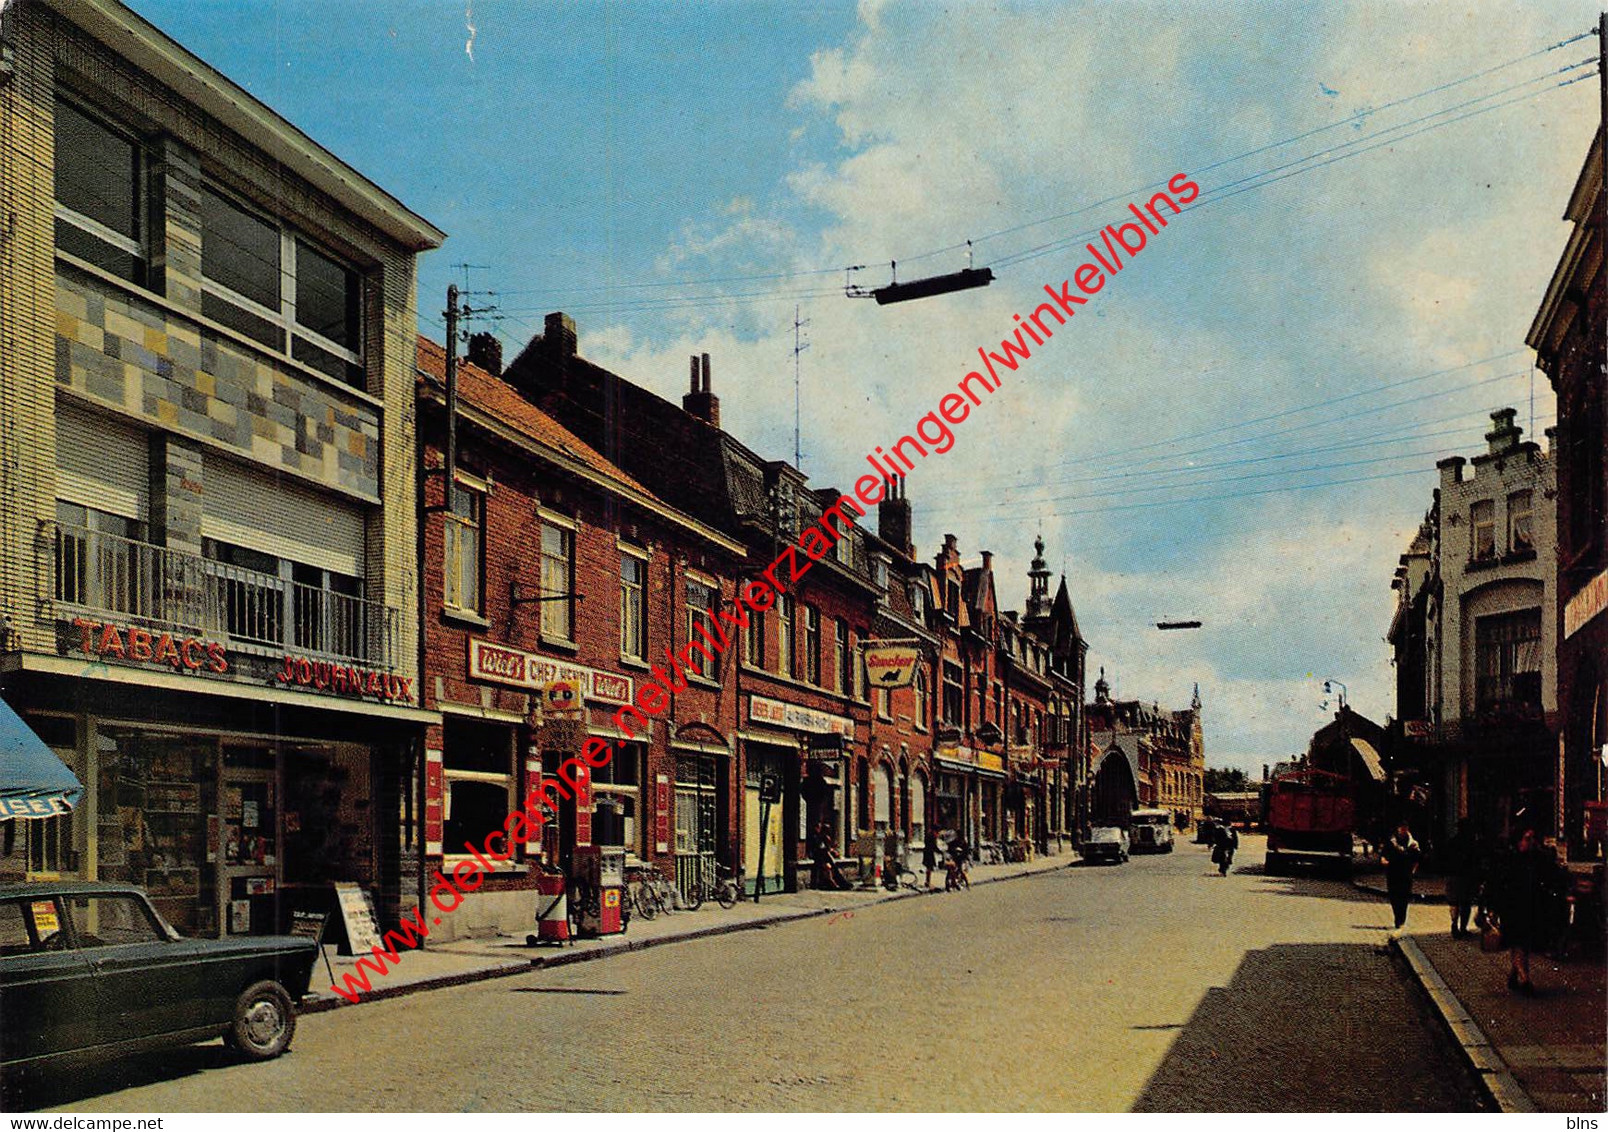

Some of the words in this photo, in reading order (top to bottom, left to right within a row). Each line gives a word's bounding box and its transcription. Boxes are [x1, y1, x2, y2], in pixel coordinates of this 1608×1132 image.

[73, 617, 229, 674] TABACS
[276, 654, 415, 703] JOURNAUX
[529, 660, 557, 682] CHEZ
